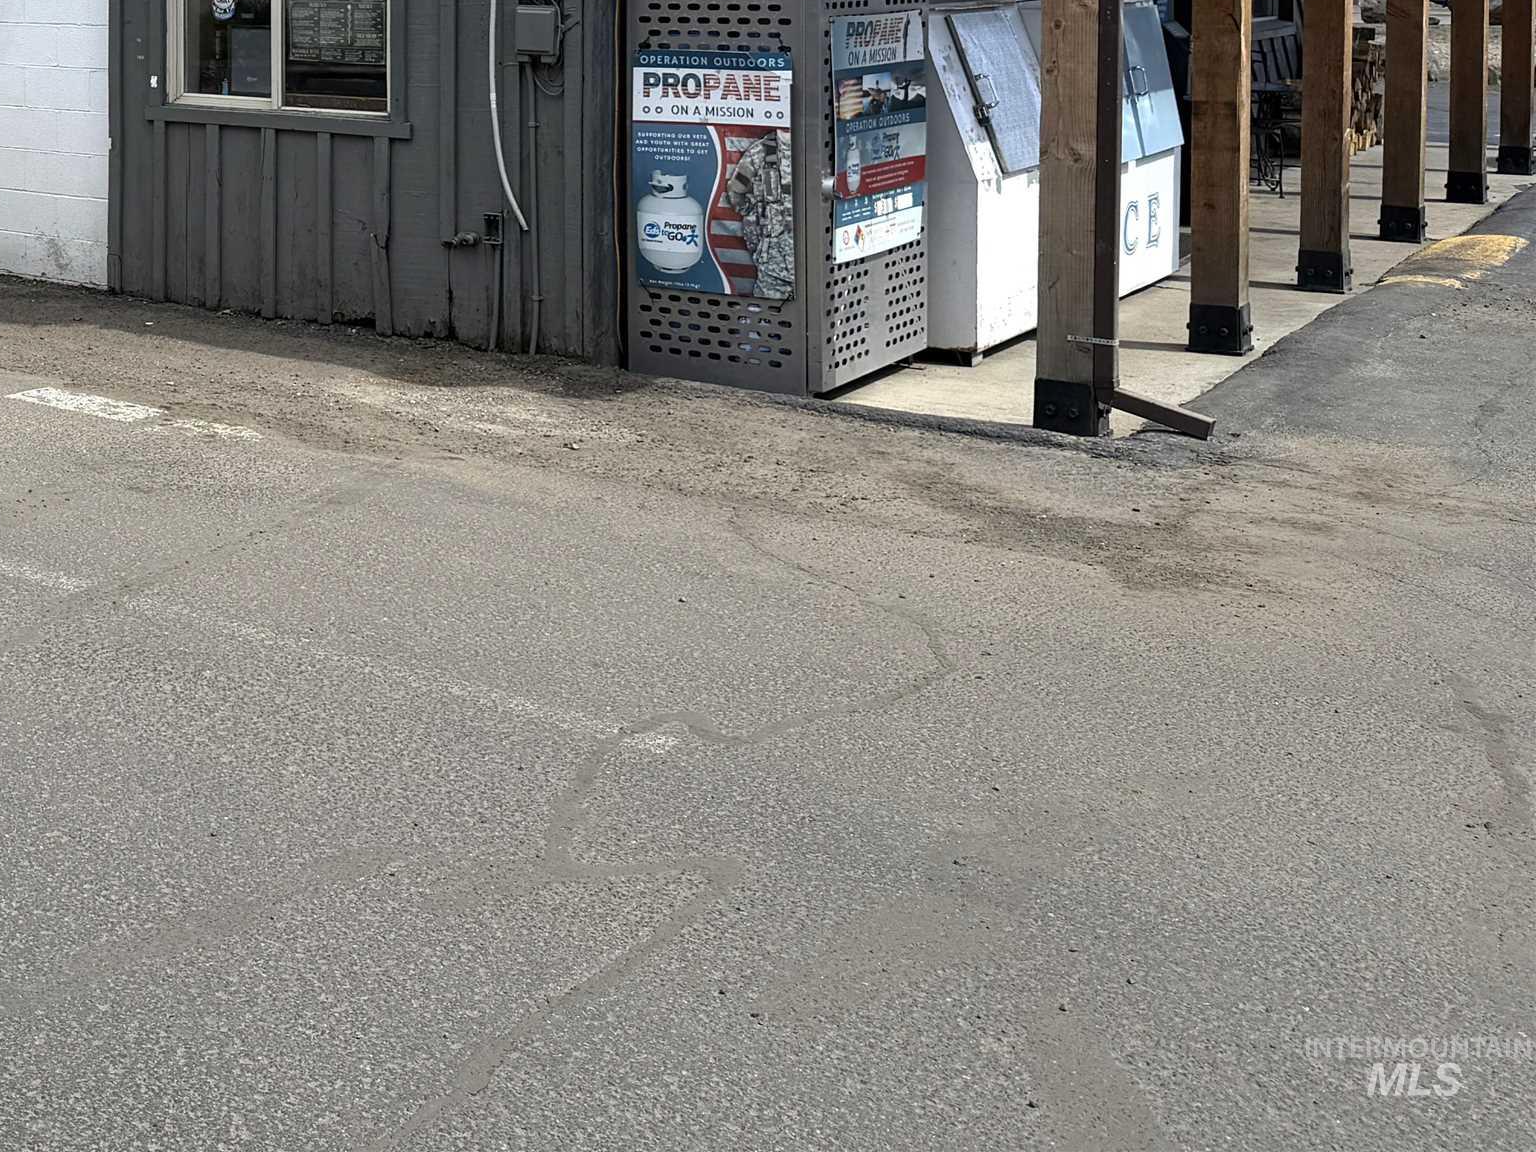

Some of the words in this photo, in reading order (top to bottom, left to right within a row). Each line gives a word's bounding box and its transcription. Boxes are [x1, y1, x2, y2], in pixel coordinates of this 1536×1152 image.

[846, 17, 904, 49] PROPANE
[639, 55, 708, 66] OPERATION
[713, 57, 785, 67] OUTDOORS
[848, 51, 860, 66] ON
[861, 51, 868, 65] A
[869, 47, 897, 64] MISSION
[642, 72, 781, 102] PROPANE
[671, 104, 688, 116] ON
[693, 105, 701, 116] A
[705, 106, 754, 118] MISSION
[846, 119, 877, 133] OPERATION
[879, 112, 911, 128] OUTDOORS
[664, 221, 697, 232] Propane
[1123, 191, 1161, 256] CE
